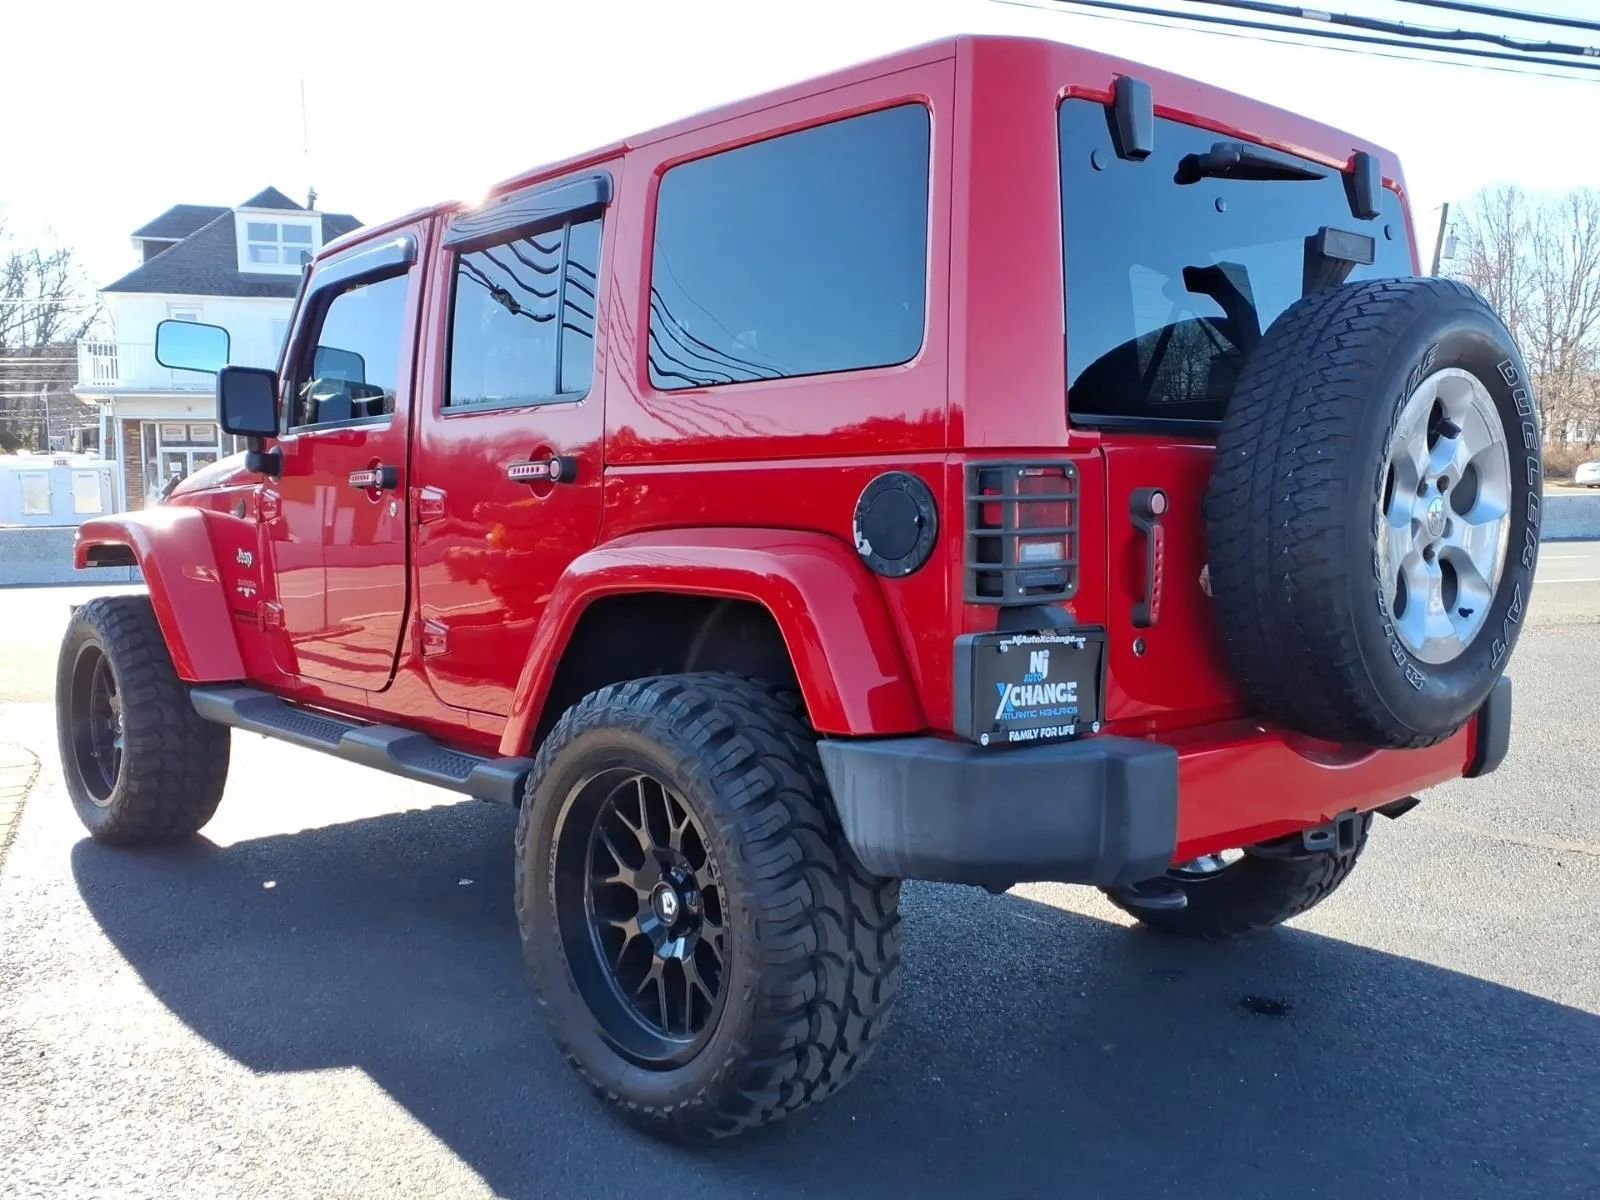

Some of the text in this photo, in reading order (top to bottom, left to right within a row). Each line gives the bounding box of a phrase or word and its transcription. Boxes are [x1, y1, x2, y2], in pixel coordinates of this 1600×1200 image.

[1490, 358, 1540, 669] DUELER A/T
[994, 681, 1077, 719] XCHANGE
[1009, 724, 1075, 742] FAMILY FOR LIFE
